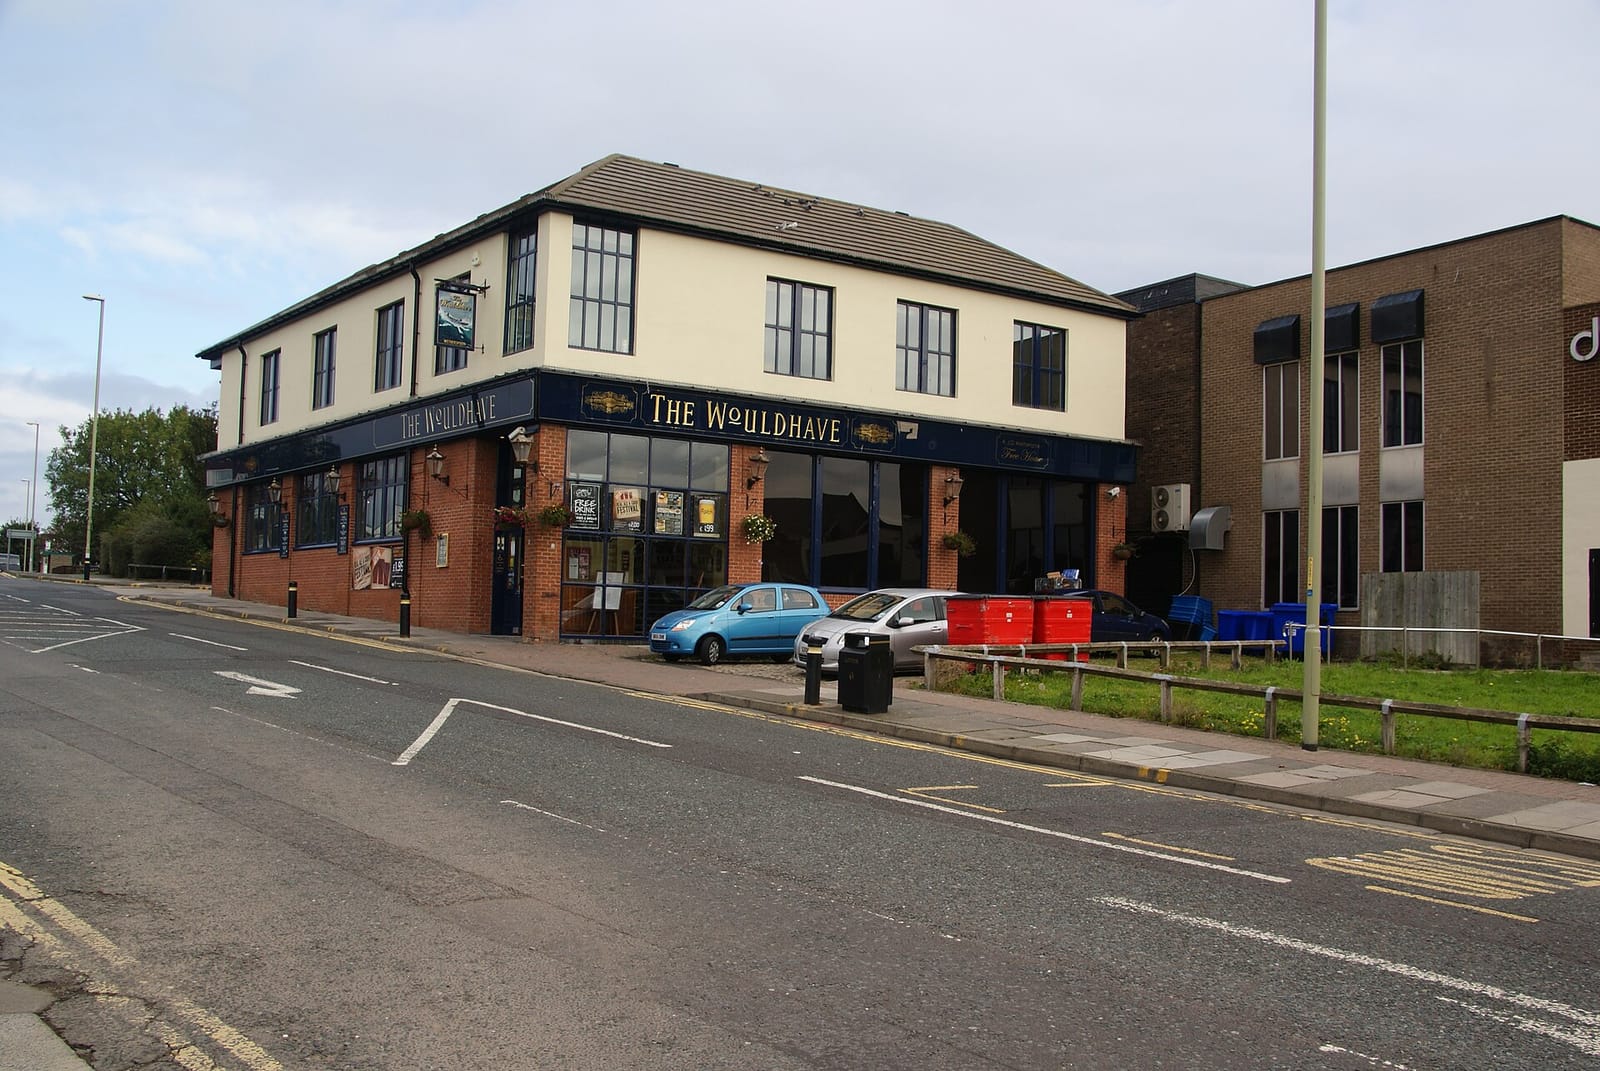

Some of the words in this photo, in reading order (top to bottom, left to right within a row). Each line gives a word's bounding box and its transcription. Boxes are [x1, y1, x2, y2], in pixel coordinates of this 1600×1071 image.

[401, 413, 421, 439] THE
[650, 394, 695, 426] THE
[706, 399, 841, 443] WOULDHAVE
[574, 499, 597, 507] FREE
[616, 503, 640, 514] FESTIVAL
